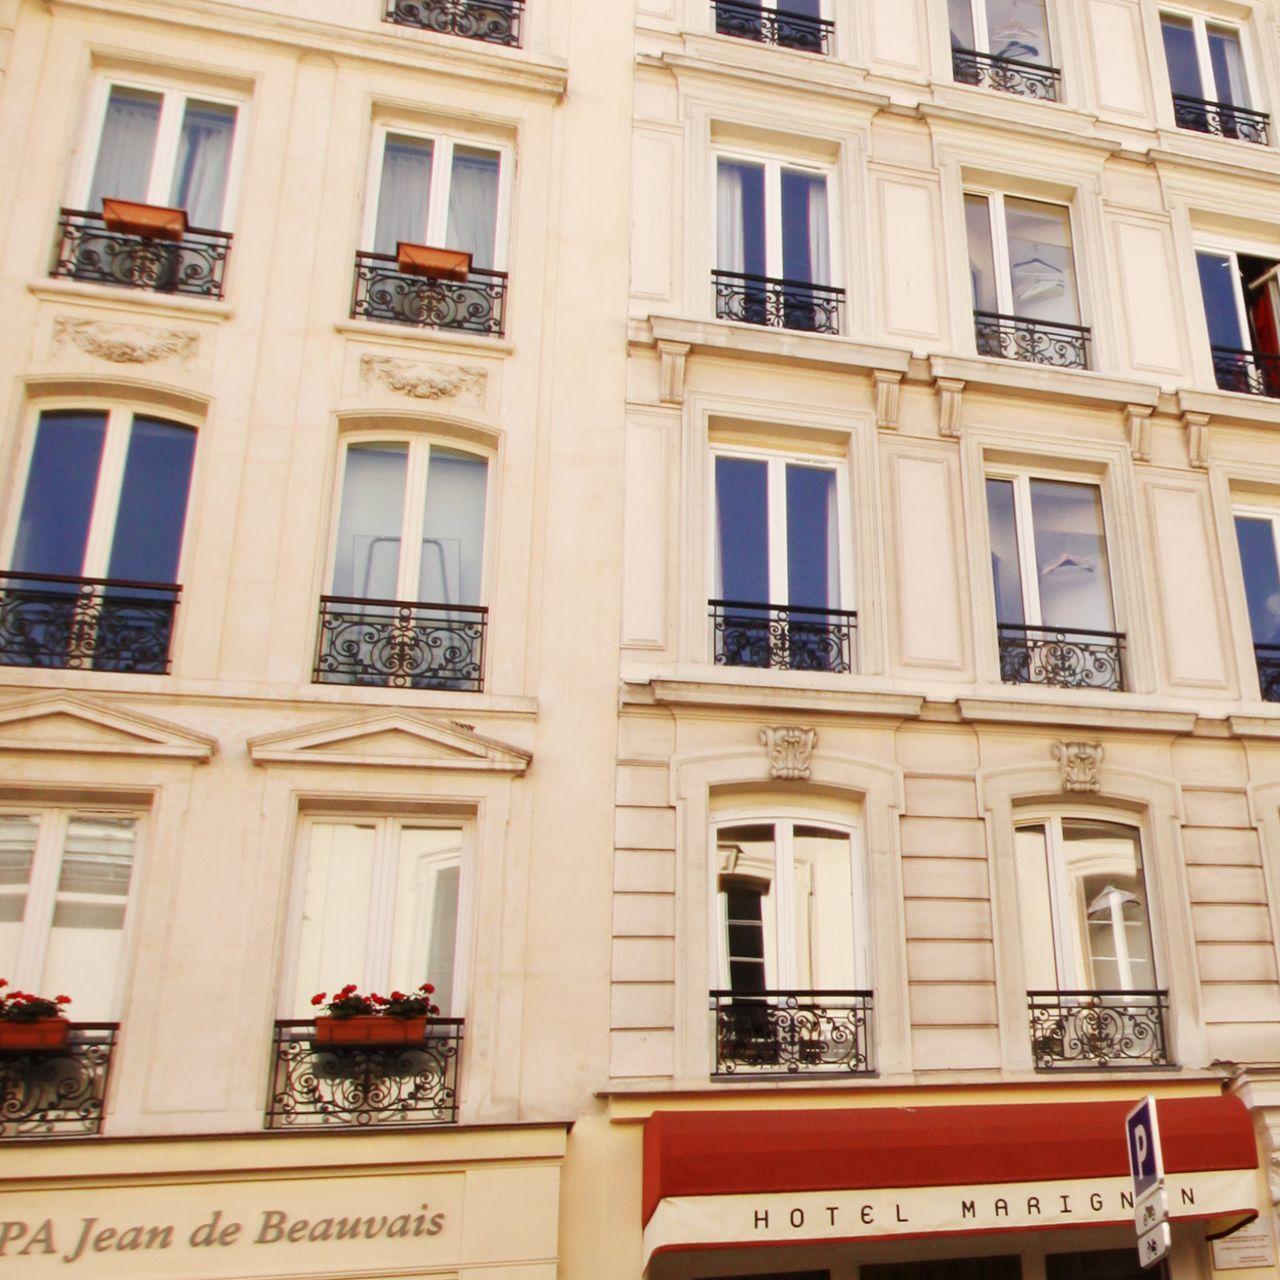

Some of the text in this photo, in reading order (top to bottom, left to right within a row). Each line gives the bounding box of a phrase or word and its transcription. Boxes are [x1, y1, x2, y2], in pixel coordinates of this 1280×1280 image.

[1134, 1123, 1148, 1180] P
[63, 1217, 175, 1264] Jean
[189, 1210, 241, 1249] de
[254, 1203, 446, 1245] Beauvais
[754, 1187, 1195, 1229] HOTEL MARIGNN
